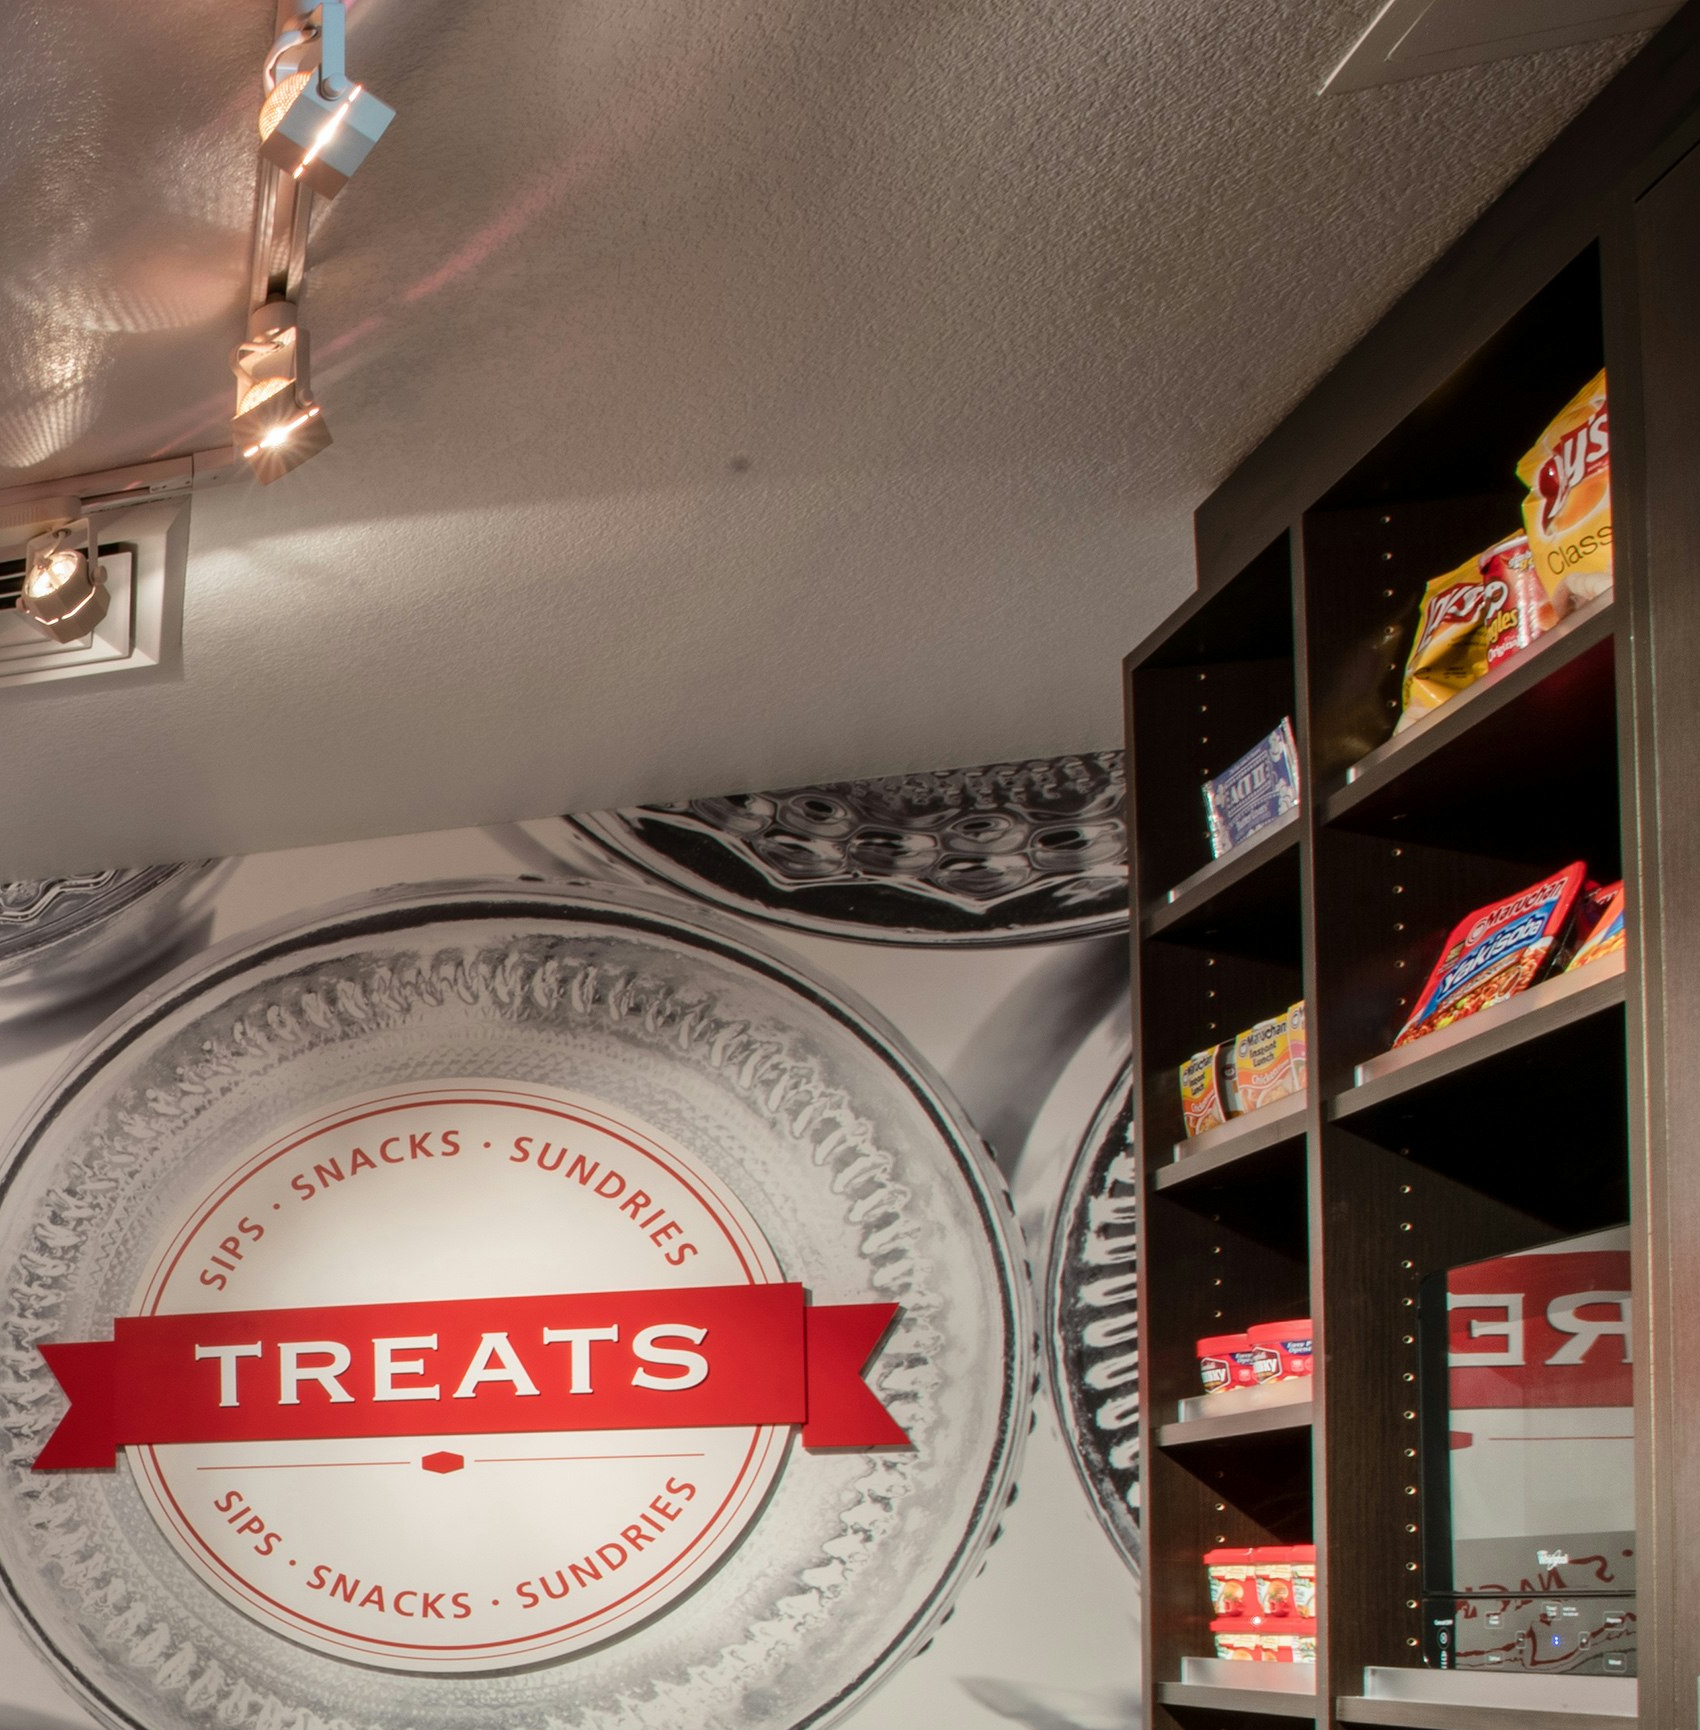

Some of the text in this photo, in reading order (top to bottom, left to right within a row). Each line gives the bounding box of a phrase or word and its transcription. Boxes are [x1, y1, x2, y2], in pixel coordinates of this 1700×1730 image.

[1484, 875, 1569, 930] Maruchan
[200, 1129, 700, 1292] SIPS SNACKS SUNDRIES
[194, 1323, 710, 1408] TREATS
[213, 1474, 698, 1621] SIPS SNACKS SUNDRIES
